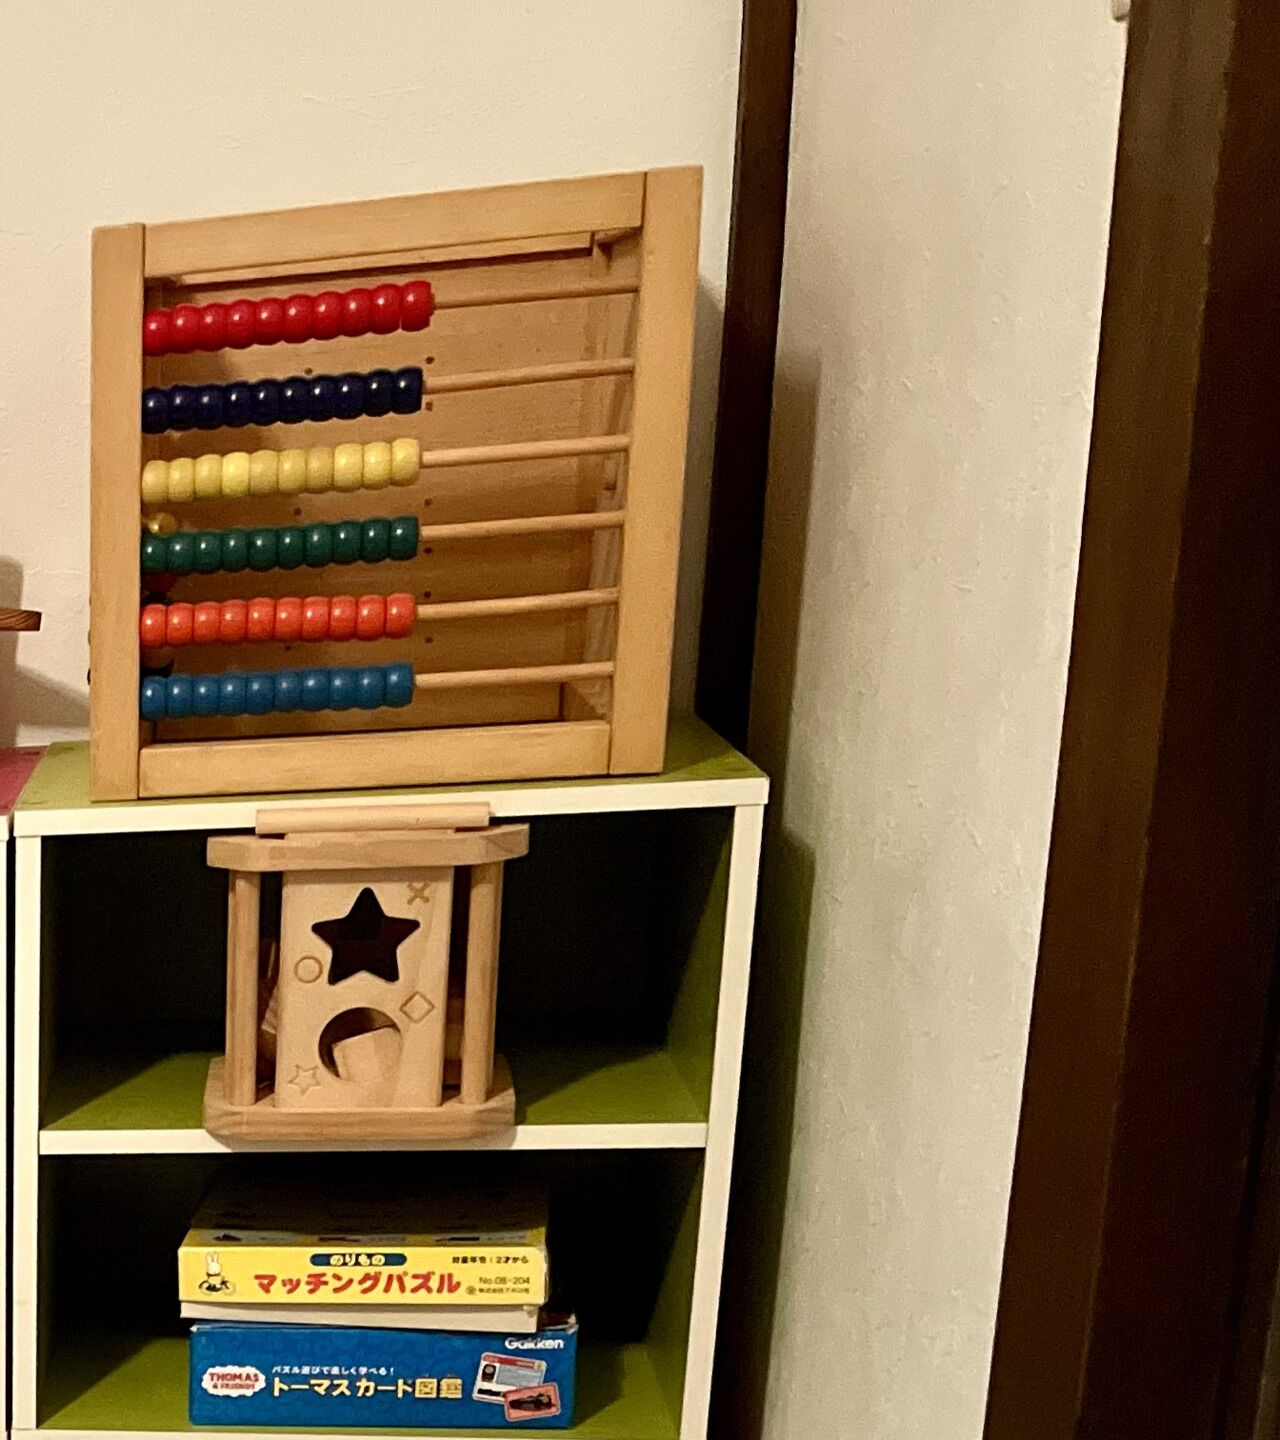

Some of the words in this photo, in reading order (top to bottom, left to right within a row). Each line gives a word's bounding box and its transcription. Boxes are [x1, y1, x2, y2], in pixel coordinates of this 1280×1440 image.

[329, 1253, 386, 1266] のりもの
[254, 1270, 462, 1295] マッチングパズル
[209, 1372, 259, 1382] THOMAS
